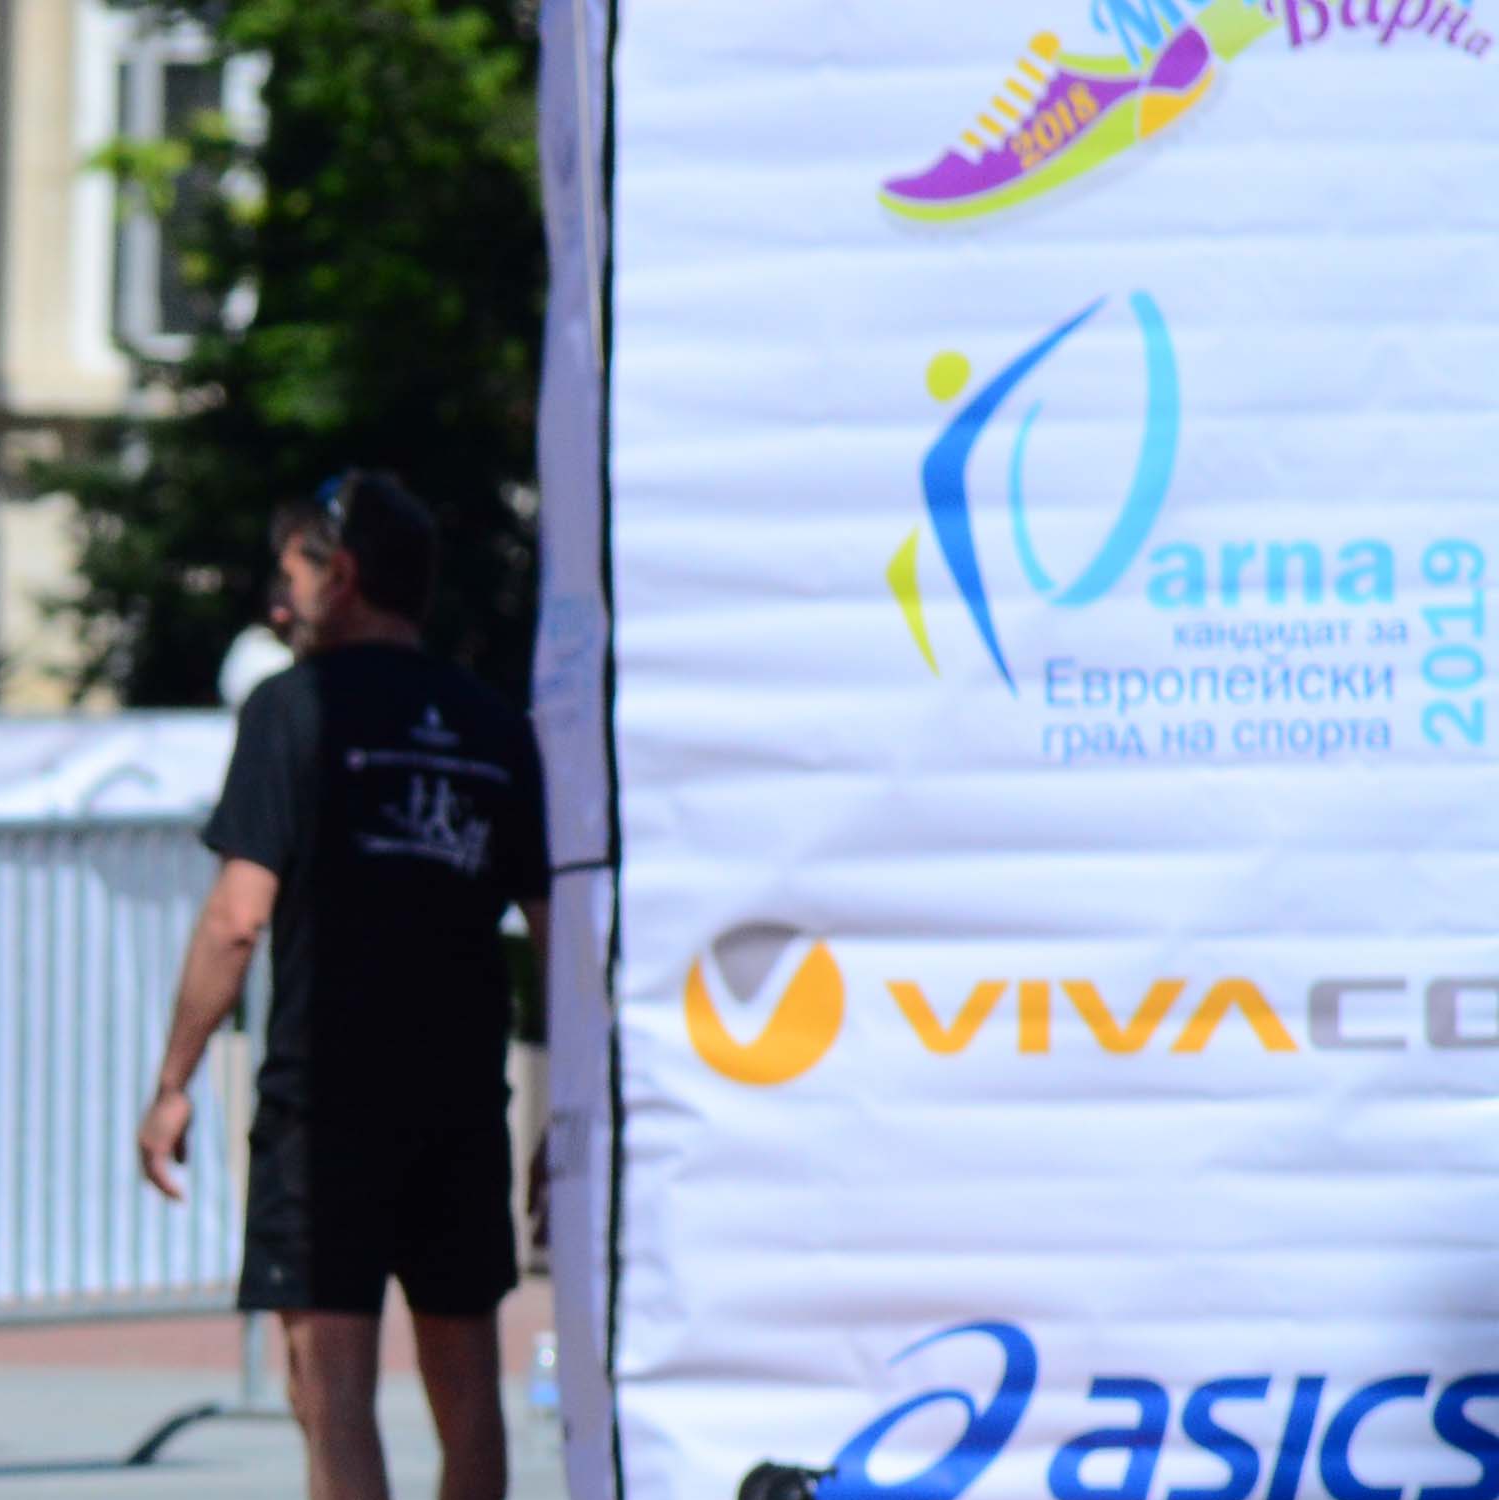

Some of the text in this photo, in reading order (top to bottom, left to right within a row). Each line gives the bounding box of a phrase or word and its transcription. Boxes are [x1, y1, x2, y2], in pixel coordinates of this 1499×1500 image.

[1011, 81, 1100, 170] 2018
[1173, 617, 1409, 650] кандидат за
[1420, 538, 1486, 746] 2019
[1043, 651, 1396, 715] Европейски
[1042, 715, 1392, 763] град на спорта
